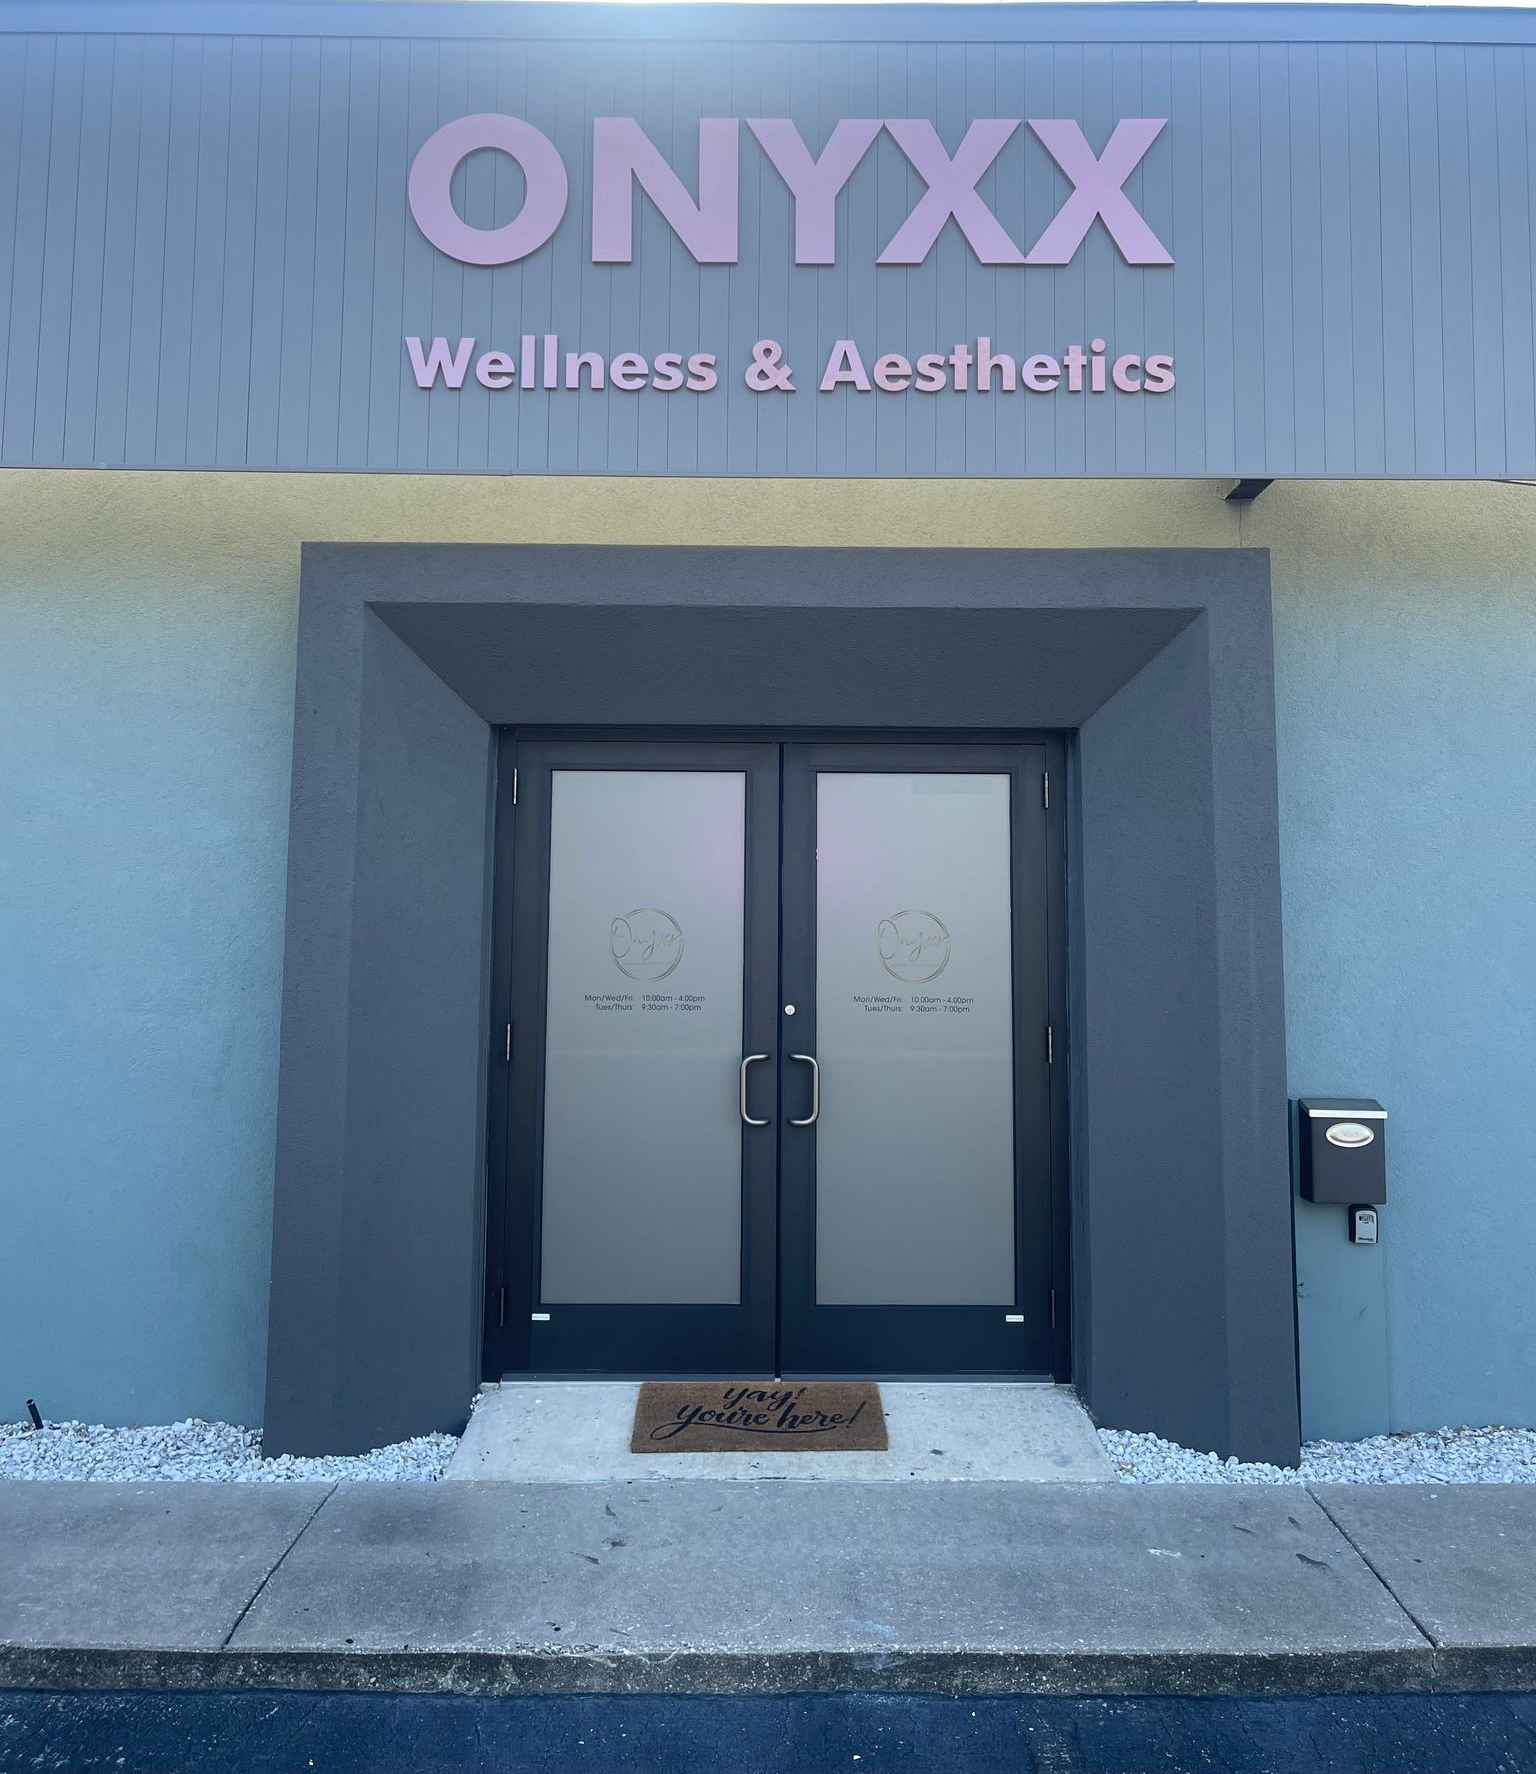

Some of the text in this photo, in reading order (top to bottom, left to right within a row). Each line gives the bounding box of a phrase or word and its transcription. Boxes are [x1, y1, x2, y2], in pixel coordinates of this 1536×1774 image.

[407, 112, 1176, 266] ONYXX
[405, 334, 1176, 392] Wellness & Aesthetics
[641, 1003, 669, 1012] 9:30am
[675, 1003, 702, 1013] 7:00pm
[642, 994, 673, 1003] 10:00am
[679, 994, 706, 1004] 4:00pm
[911, 996, 941, 1004] 10:00am
[947, 996, 974, 1006] 4:00pm
[910, 1005, 938, 1014] 9:30am
[943, 1005, 971, 1015] 7:00pm
[722, 1386, 808, 1412] yay!
[650, 1400, 867, 1440] you're here!
